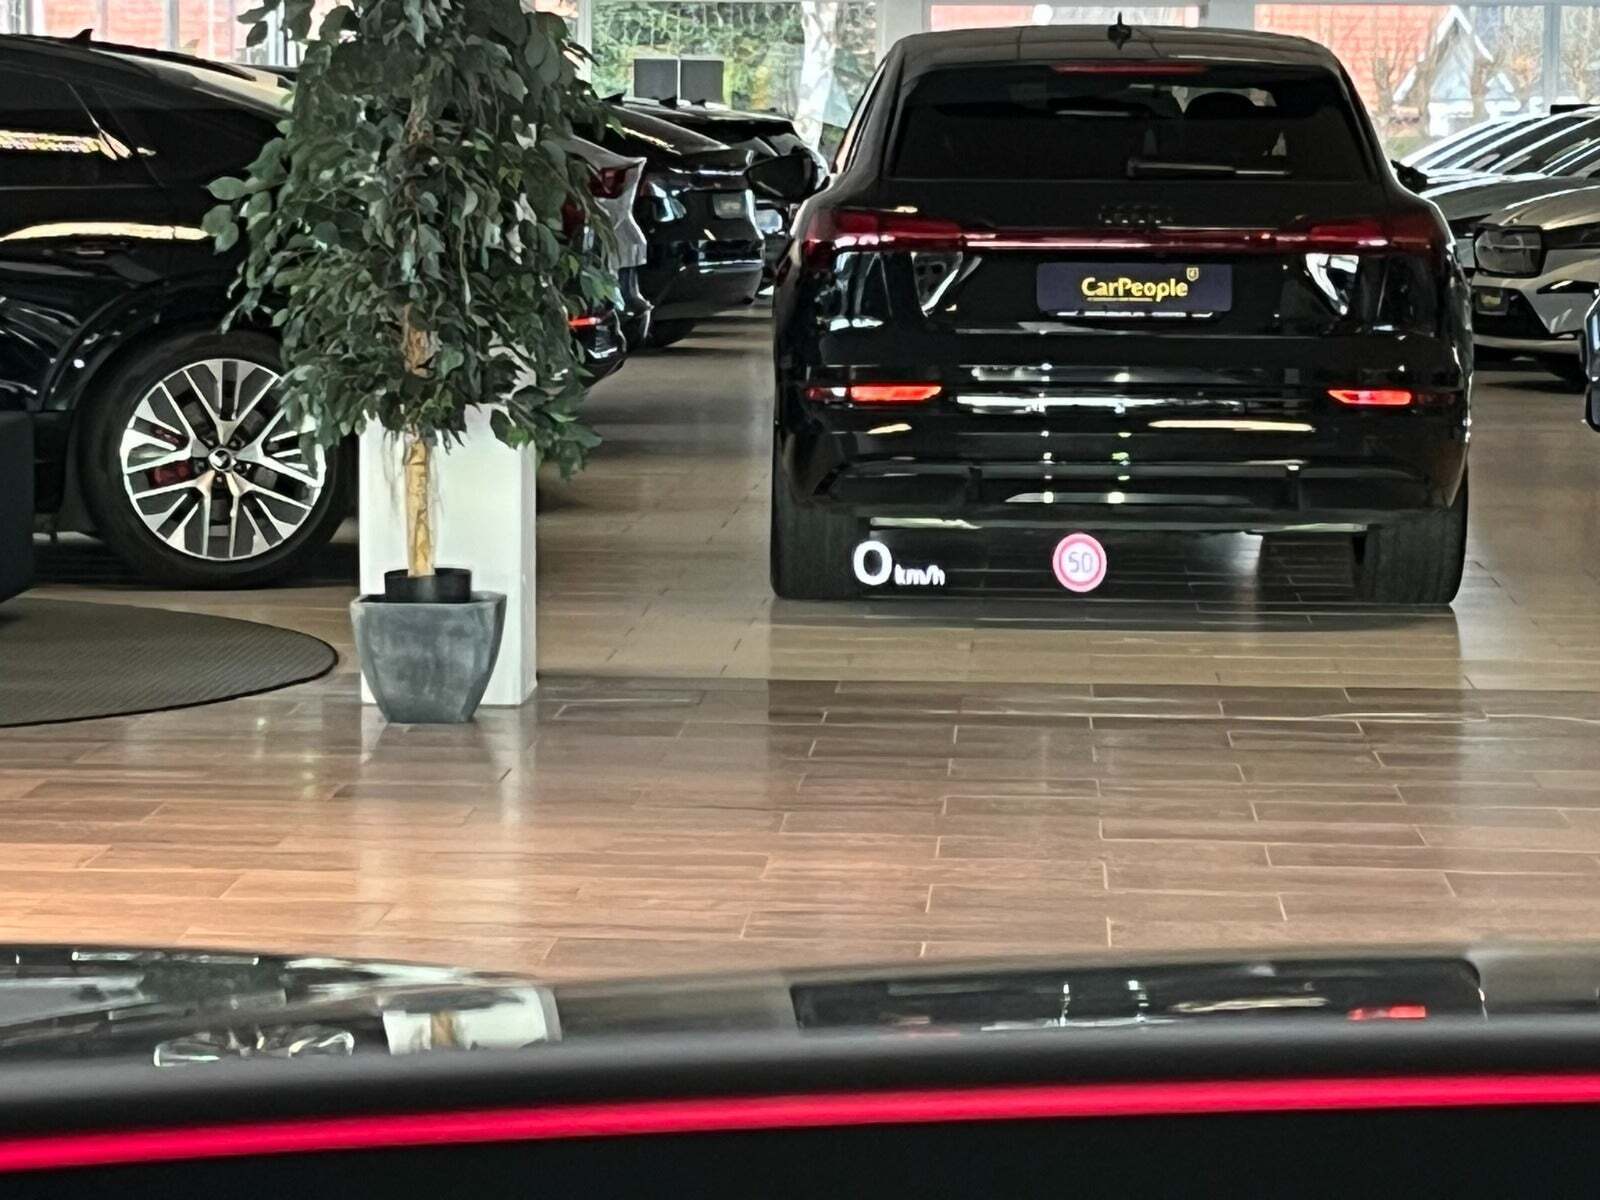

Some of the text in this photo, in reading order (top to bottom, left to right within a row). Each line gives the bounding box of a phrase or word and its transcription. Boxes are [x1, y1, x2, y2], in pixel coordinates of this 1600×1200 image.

[1081, 277, 1189, 303] CarPeople
[853, 540, 946, 587] 0 km/h
[1066, 550, 1094, 575] 50
